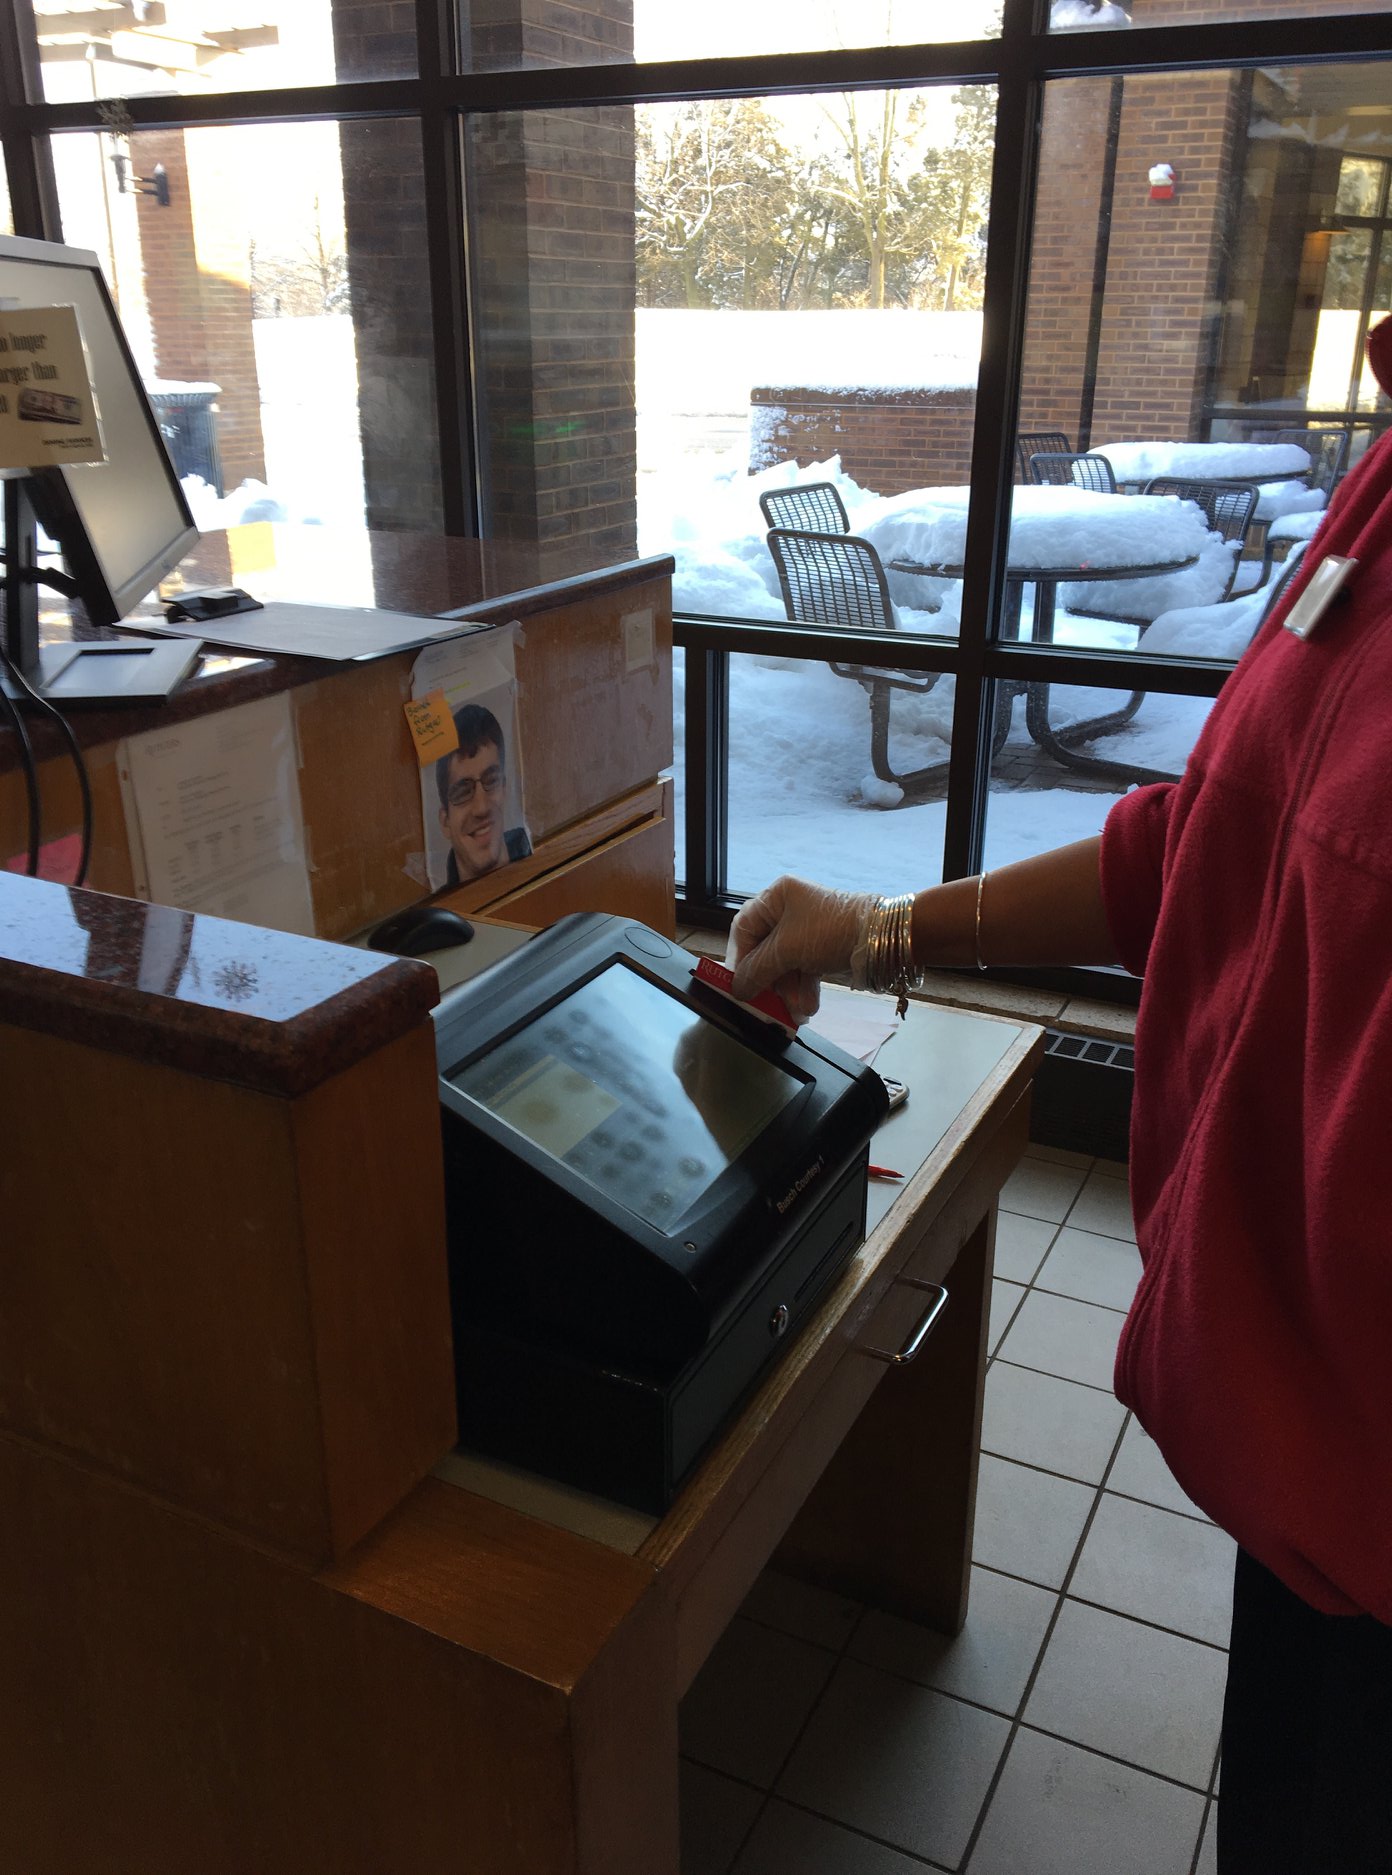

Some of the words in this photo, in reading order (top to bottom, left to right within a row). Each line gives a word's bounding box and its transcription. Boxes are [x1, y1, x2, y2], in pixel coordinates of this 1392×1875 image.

[8, 332, 48, 354] longer
[0, 366, 29, 385] arger
[31, 361, 58, 380] than
[701, 958, 732, 984] RUTG
[776, 1188, 798, 1214] Busch
[794, 1160, 820, 1192] Courtesy
